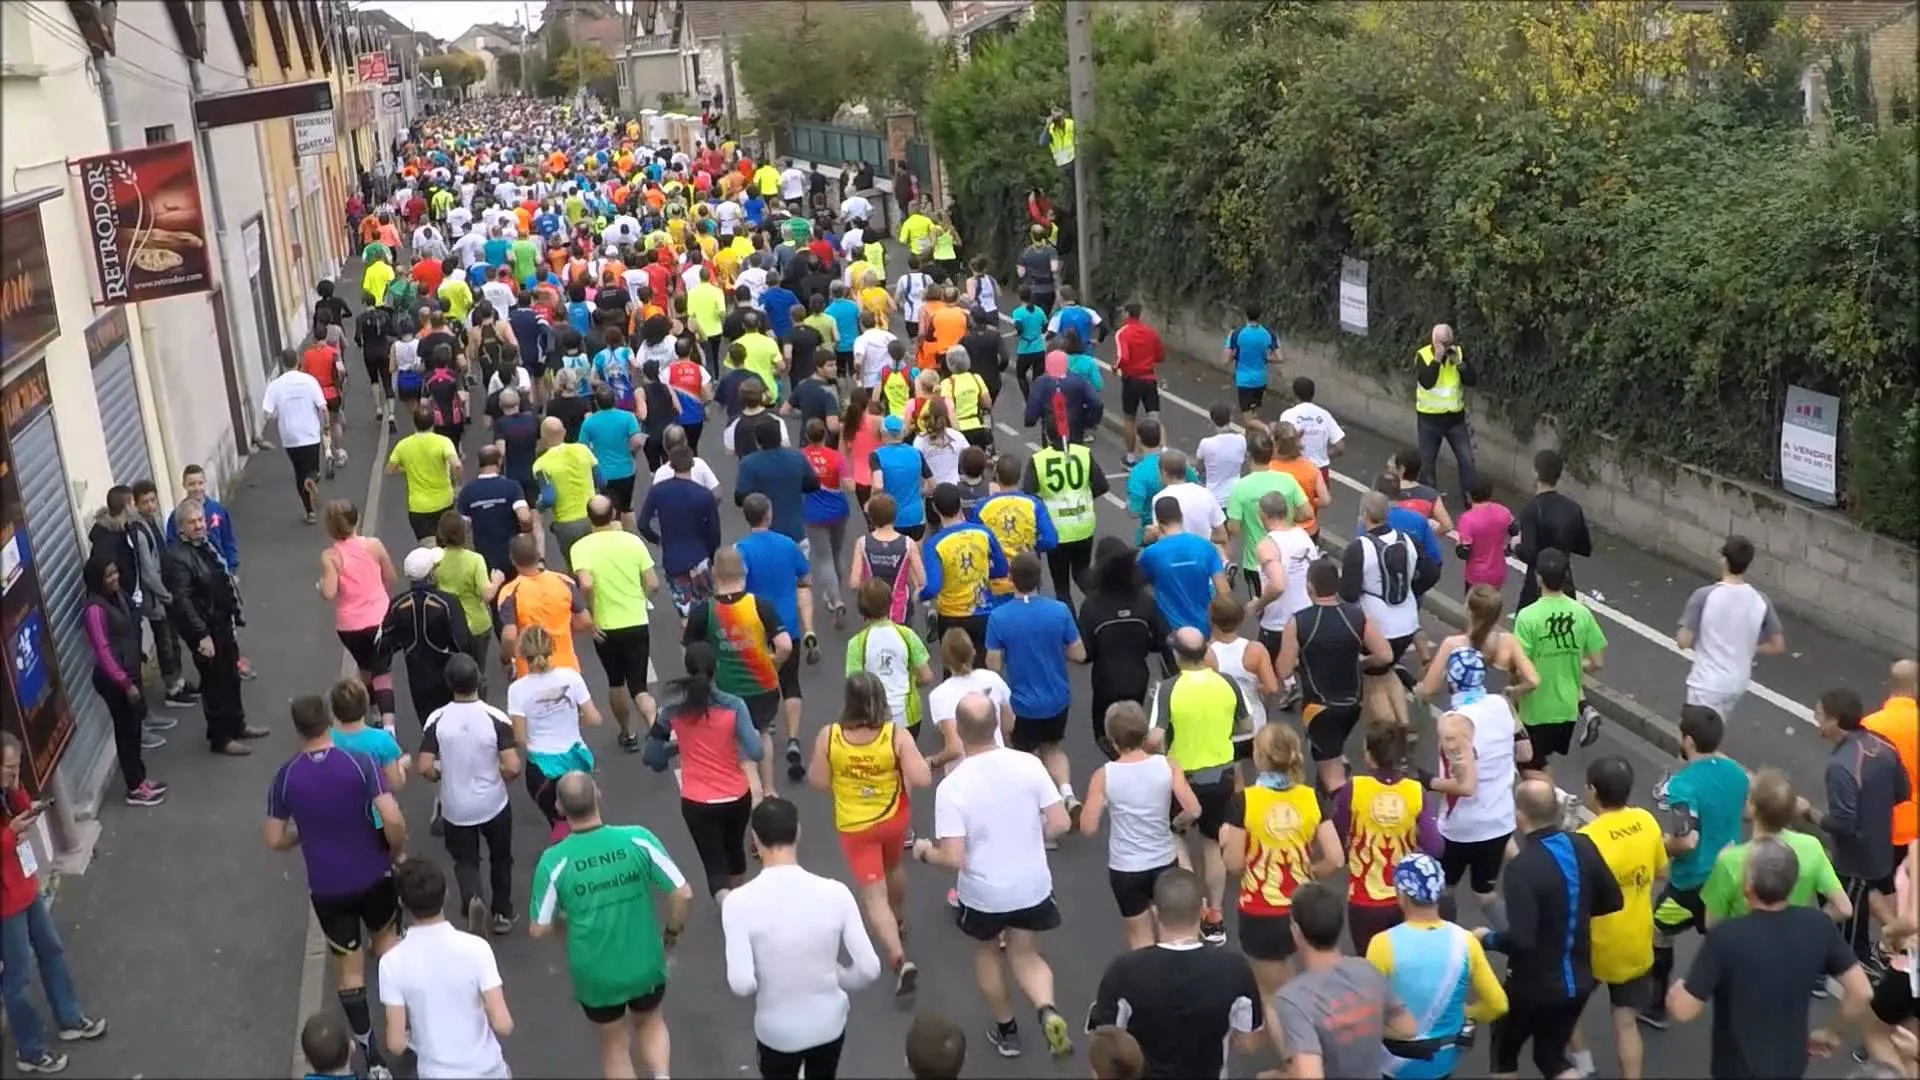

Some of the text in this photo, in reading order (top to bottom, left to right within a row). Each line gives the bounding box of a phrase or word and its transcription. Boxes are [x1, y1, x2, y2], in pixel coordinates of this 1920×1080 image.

[87, 163, 128, 300] RETRODOR
[134, 272, 204, 289] www.retrodor.com
[1793, 443, 1833, 462] VENDRE
[1046, 455, 1083, 492] 50
[574, 848, 628, 872] DENIS
